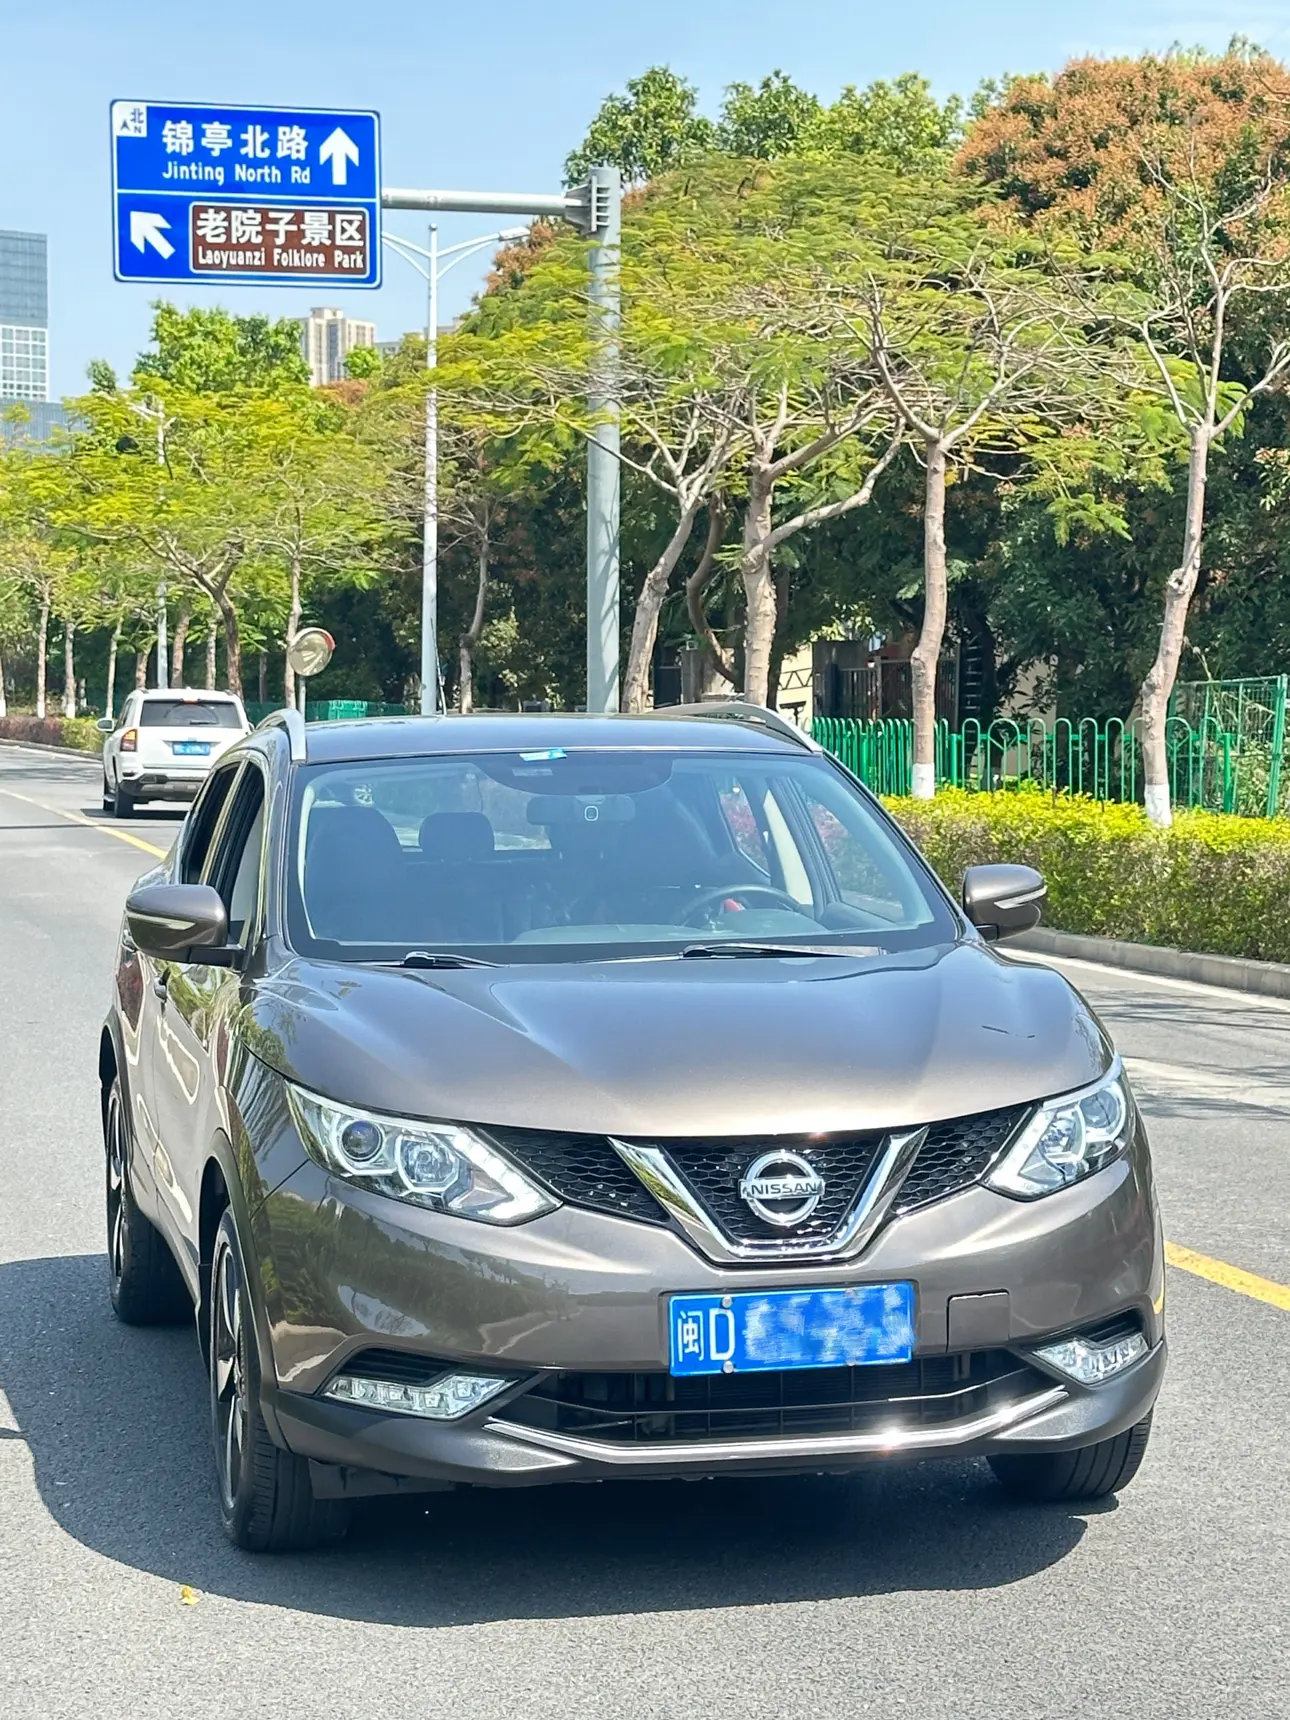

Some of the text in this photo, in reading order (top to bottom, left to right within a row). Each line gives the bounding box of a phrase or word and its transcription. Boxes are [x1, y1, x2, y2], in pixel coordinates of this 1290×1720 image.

[130, 108, 144, 125] 北
[133, 126, 142, 134] N
[161, 120, 309, 161] 锦亭北路
[162, 162, 310, 185] Jinting North Rd
[196, 208, 365, 247] 老院子景区
[198, 246, 364, 270] Laoyuanzi Folklore Park
[751, 1182, 817, 1195] NISSAN
